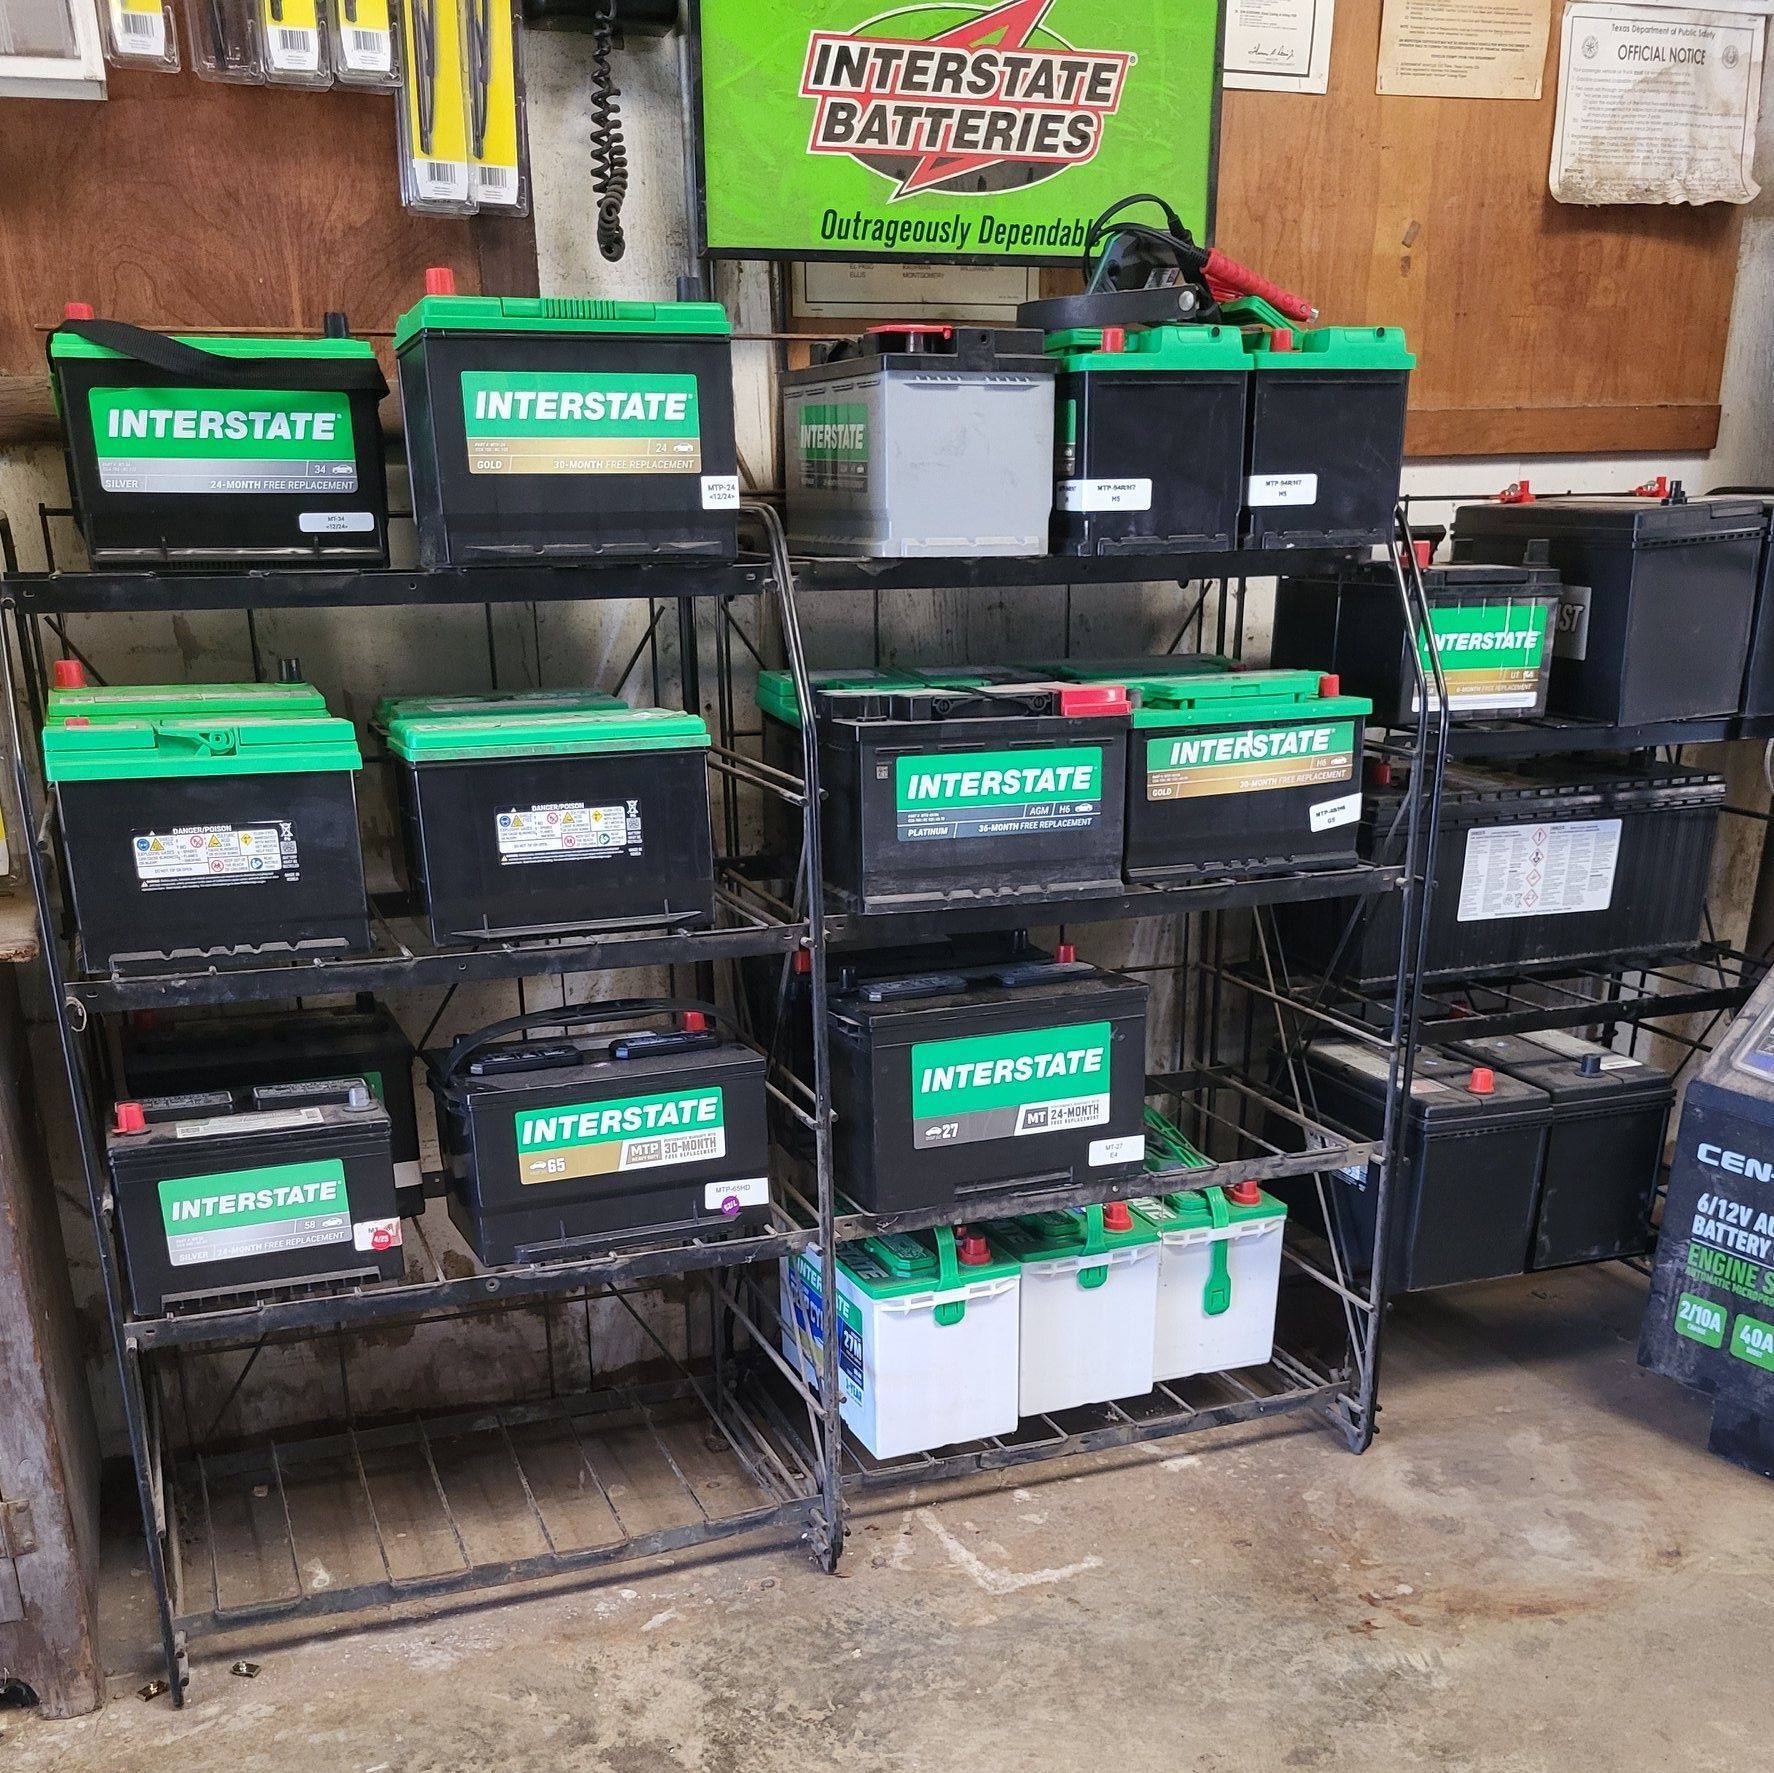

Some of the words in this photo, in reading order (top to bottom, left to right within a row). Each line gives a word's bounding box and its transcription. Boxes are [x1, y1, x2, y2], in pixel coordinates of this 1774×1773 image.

[1611, 24, 1630, 33] Texas
[1632, 25, 1669, 36] Department
[1678, 28, 1697, 37] Public
[1699, 30, 1716, 40] Safety
[1617, 44, 1666, 62] OFFICIAL
[1669, 47, 1706, 65] NOTICE
[812, 44, 1119, 103] INTERSTATE
[822, 101, 1096, 154] BATTERIES
[821, 208, 971, 249] Outrageously
[978, 215, 1100, 247] Dependabl
[475, 390, 687, 421] INTERSTATE
[108, 409, 336, 441] INTERSTATE
[801, 424, 864, 449] INTERSTATE
[656, 444, 667, 453] 24
[314, 465, 326, 474] 34
[477, 460, 502, 470] GOLD
[554, 460, 603, 470] 30-MONTH
[605, 460, 628, 470] FREE
[629, 460, 694, 470] REPLACEMENT
[105, 480, 138, 489] SILVER
[210, 480, 261, 490] 24-MONTH
[263, 481, 286, 490] FREE
[288, 481, 354, 491] REPLACEMENT
[1170, 728, 1331, 766] INTERSTATE
[1317, 759, 1327, 767] H6
[907, 765, 1093, 800] INTERSTATE
[1278, 776, 1295, 784] FREE
[1297, 770, 1346, 782] REPLACEMENT
[1152, 788, 1172, 797] GOLD
[531, 803, 585, 812] DANGER/POISON
[1029, 806, 1049, 816] AGM
[1059, 805, 1071, 814] H6
[172, 825, 232, 835] DANGER/POISON
[908, 827, 948, 837] PLATINUM
[978, 822, 1019, 833] 36-MONTH
[1020, 820, 1038, 830] FREE
[1039, 817, 1093, 829] REPLACEMENT
[921, 1047, 1104, 1094] INTERSTATE
[522, 1096, 719, 1145] INTERSTATE
[1027, 1112, 1046, 1125] MT
[1051, 1103, 1099, 1120] 24-MONTH
[1065, 1115, 1099, 1124] REPLACEMENT
[942, 1123, 959, 1138] 27
[631, 1143, 659, 1156] MTP
[664, 1137, 716, 1154] 30-MONTH
[680, 1148, 717, 1157] REPLACEMENT
[1105, 1143, 1123, 1151] MT-27
[547, 1158, 566, 1173] 65
[716, 1184, 751, 1193] MTP-65HD
[171, 1180, 338, 1221] INTERSTATE
[1697, 1192, 1753, 1228] 6/12V
[304, 1220, 316, 1230] 58
[217, 1244, 262, 1257] 24-MONTH
[263, 1240, 284, 1251] FREE
[285, 1232, 345, 1247] REPLACEMENT
[1692, 1214, 1772, 1259] BATTERY
[179, 1251, 209, 1262] SILVER
[1688, 1244, 1760, 1289] ENGINE
[1684, 1266, 1731, 1291] AUTOMATIC
[1679, 1300, 1721, 1333] 2/10A
[843, 1330, 862, 1361] 27M
[1740, 1325, 1773, 1354] 40A
